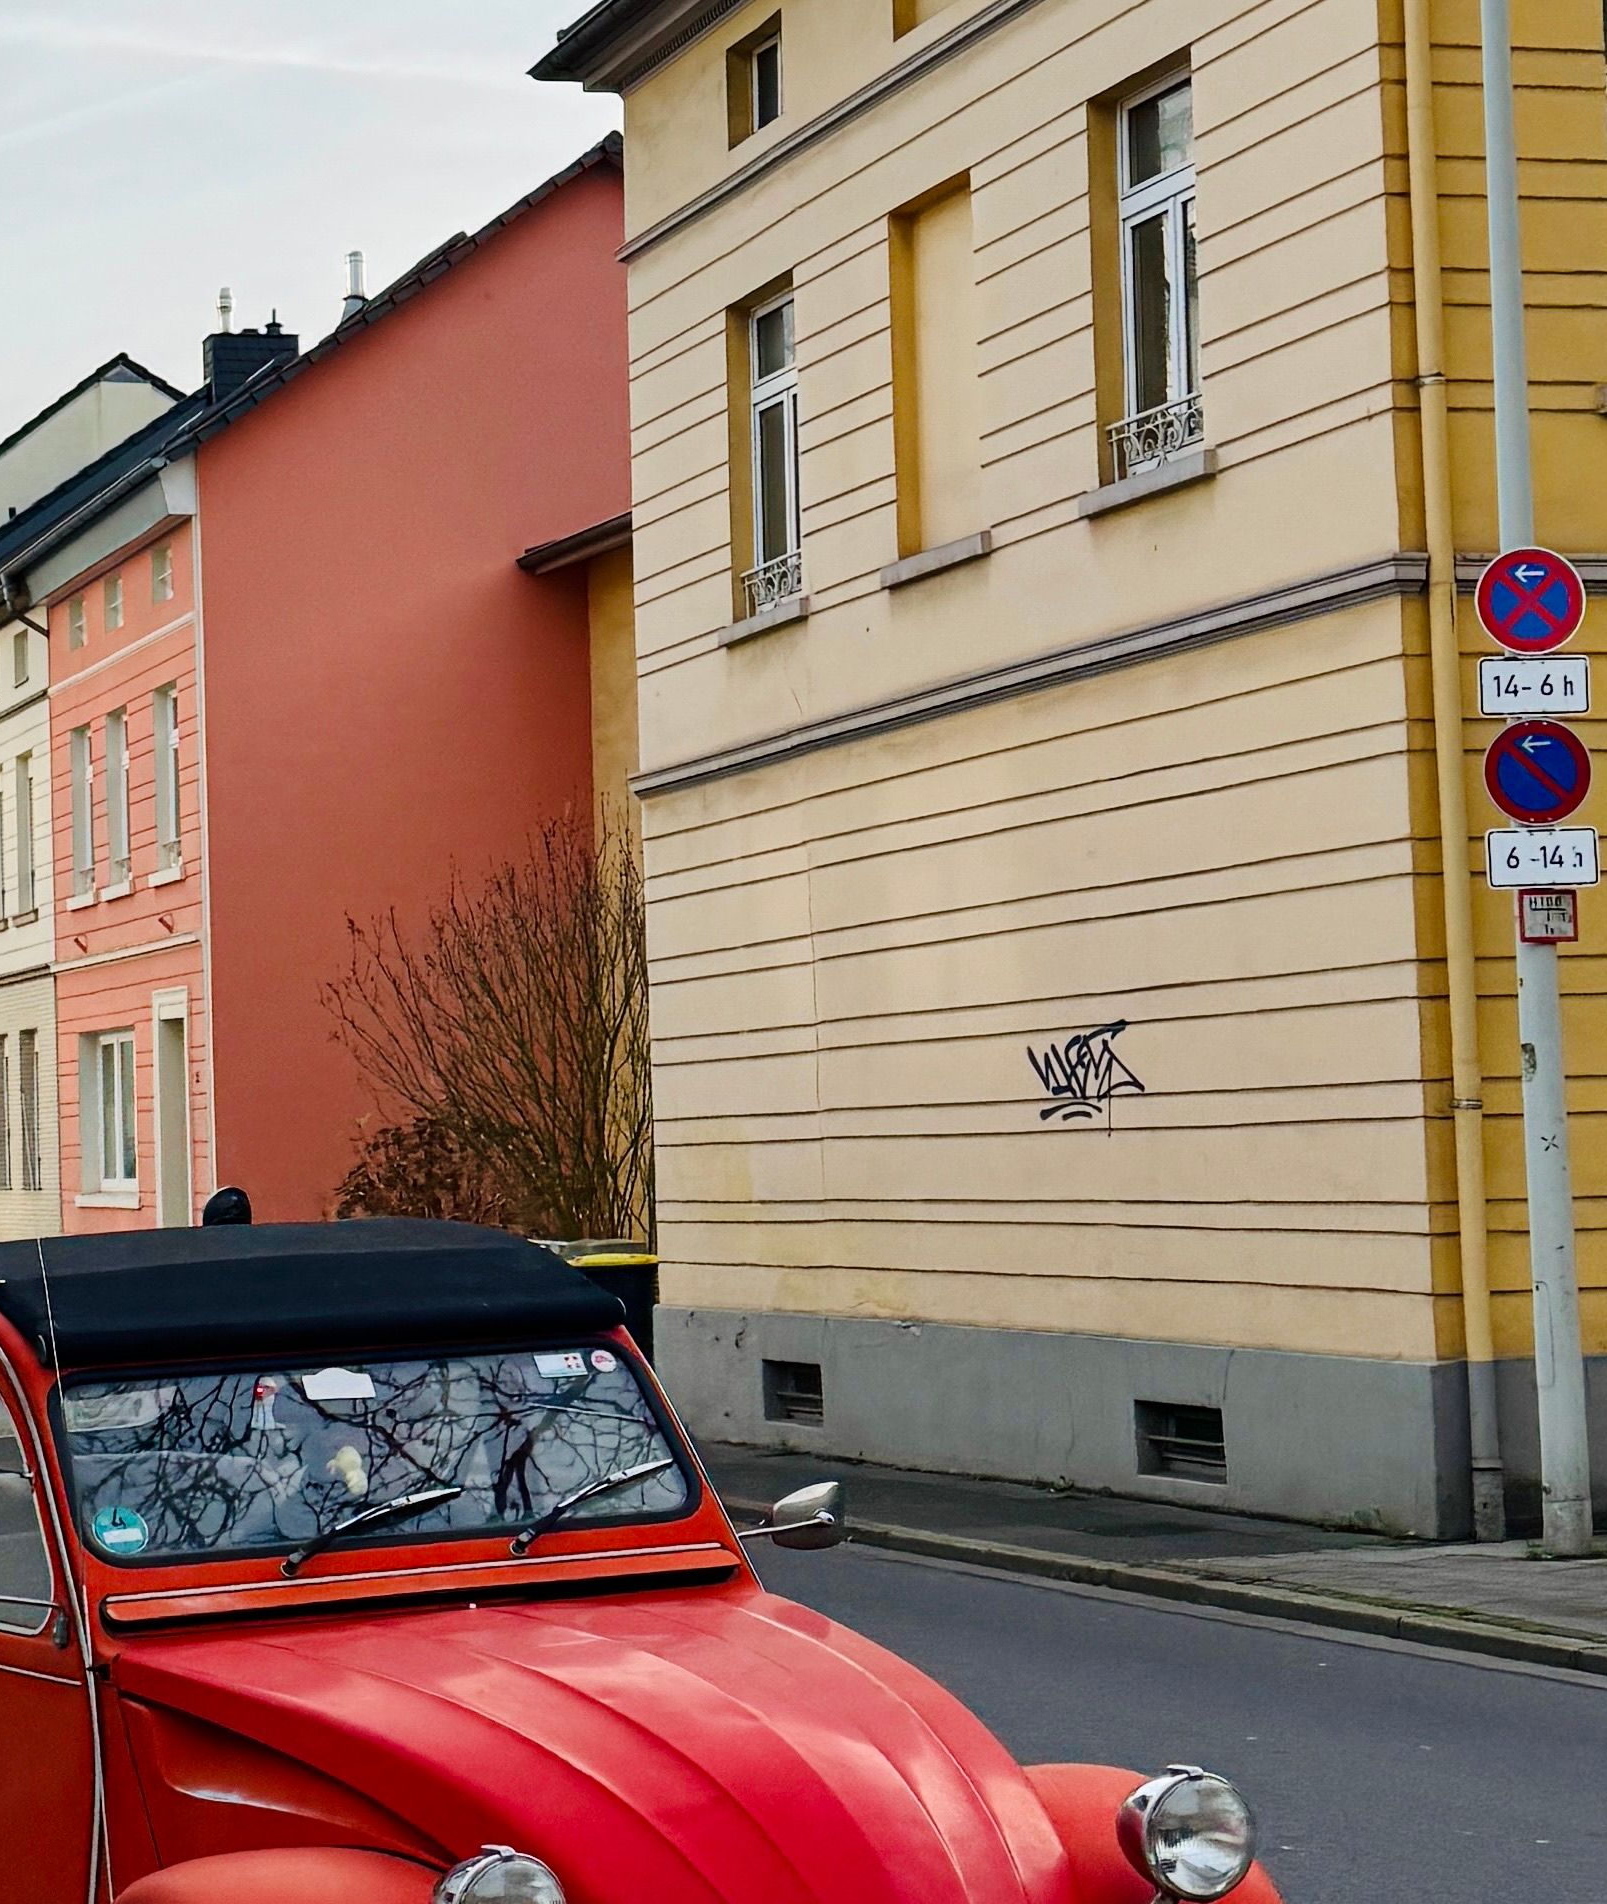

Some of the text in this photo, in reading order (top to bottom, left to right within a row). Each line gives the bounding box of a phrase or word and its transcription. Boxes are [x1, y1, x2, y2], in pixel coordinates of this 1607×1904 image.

[1540, 673, 1554, 696] 6
[1564, 674, 1574, 697] h
[1506, 846, 1520, 869] 6
